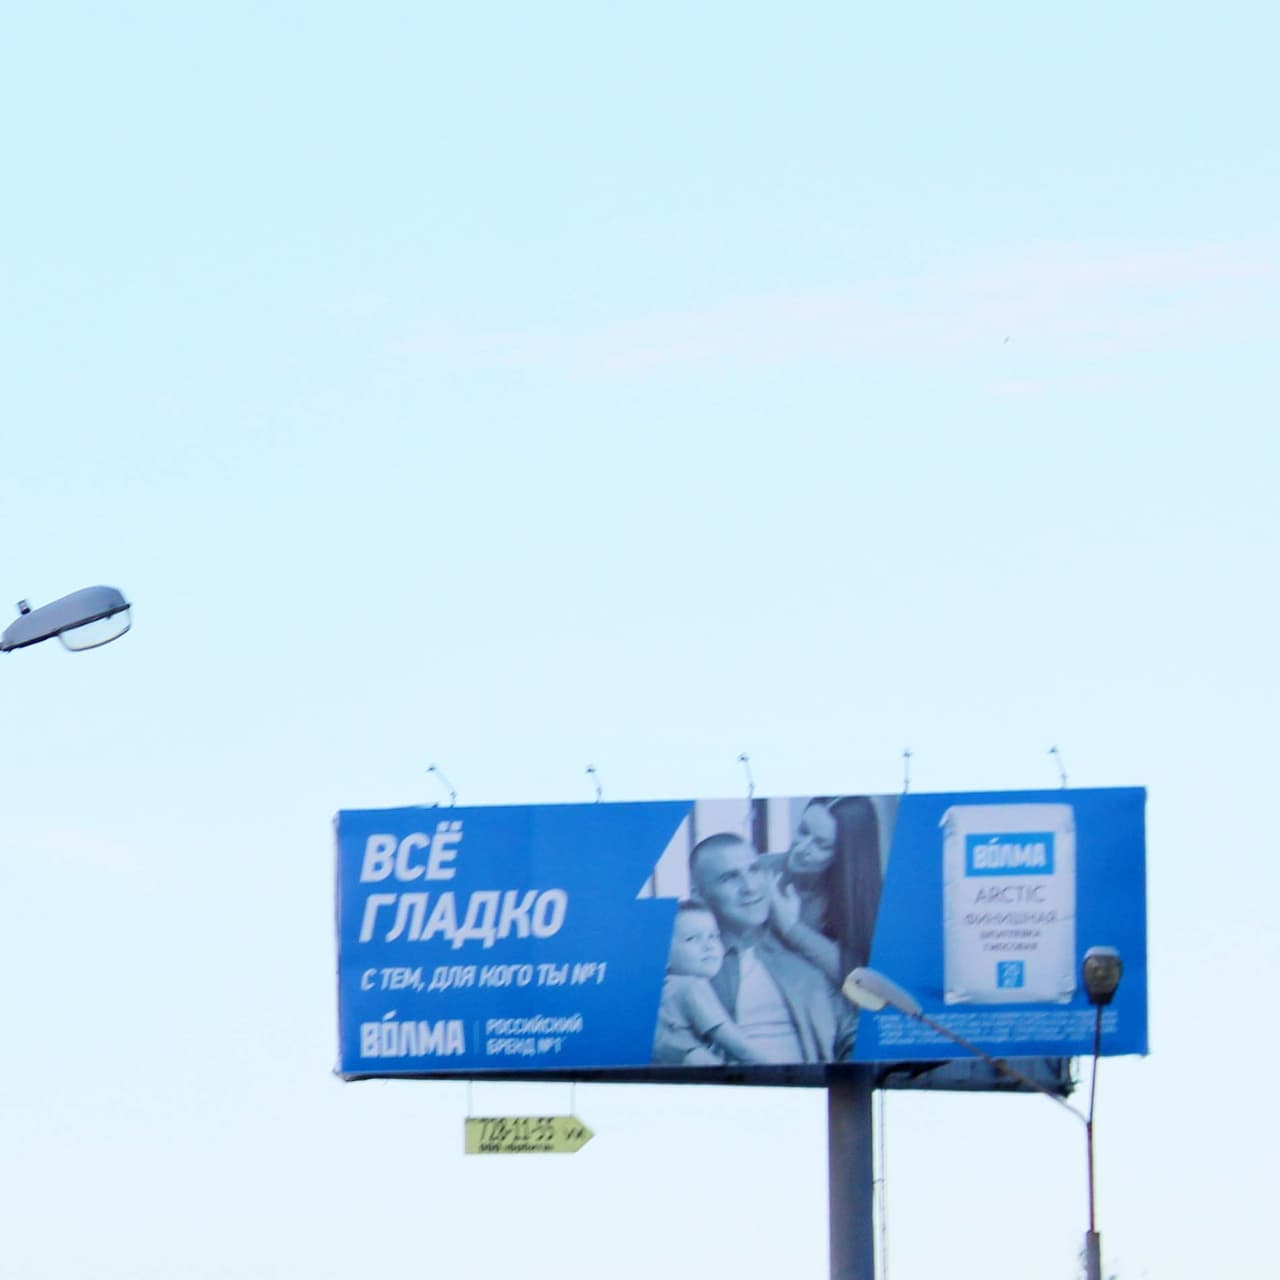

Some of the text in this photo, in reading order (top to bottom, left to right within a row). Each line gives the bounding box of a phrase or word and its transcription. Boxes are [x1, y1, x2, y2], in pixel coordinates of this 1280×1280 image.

[360, 820, 463, 883] ВСЁ
[974, 885, 1047, 904] ARCTIC
[359, 888, 568, 949] ГЛАДКО
[361, 968, 376, 991] С
[380, 967, 424, 992] ТЕМ,
[428, 965, 476, 991] ДЛЯ
[478, 963, 532, 988] КОГО
[537, 963, 569, 987] ТЫ
[486, 1013, 583, 1035] РОССИЙСКИЙ
